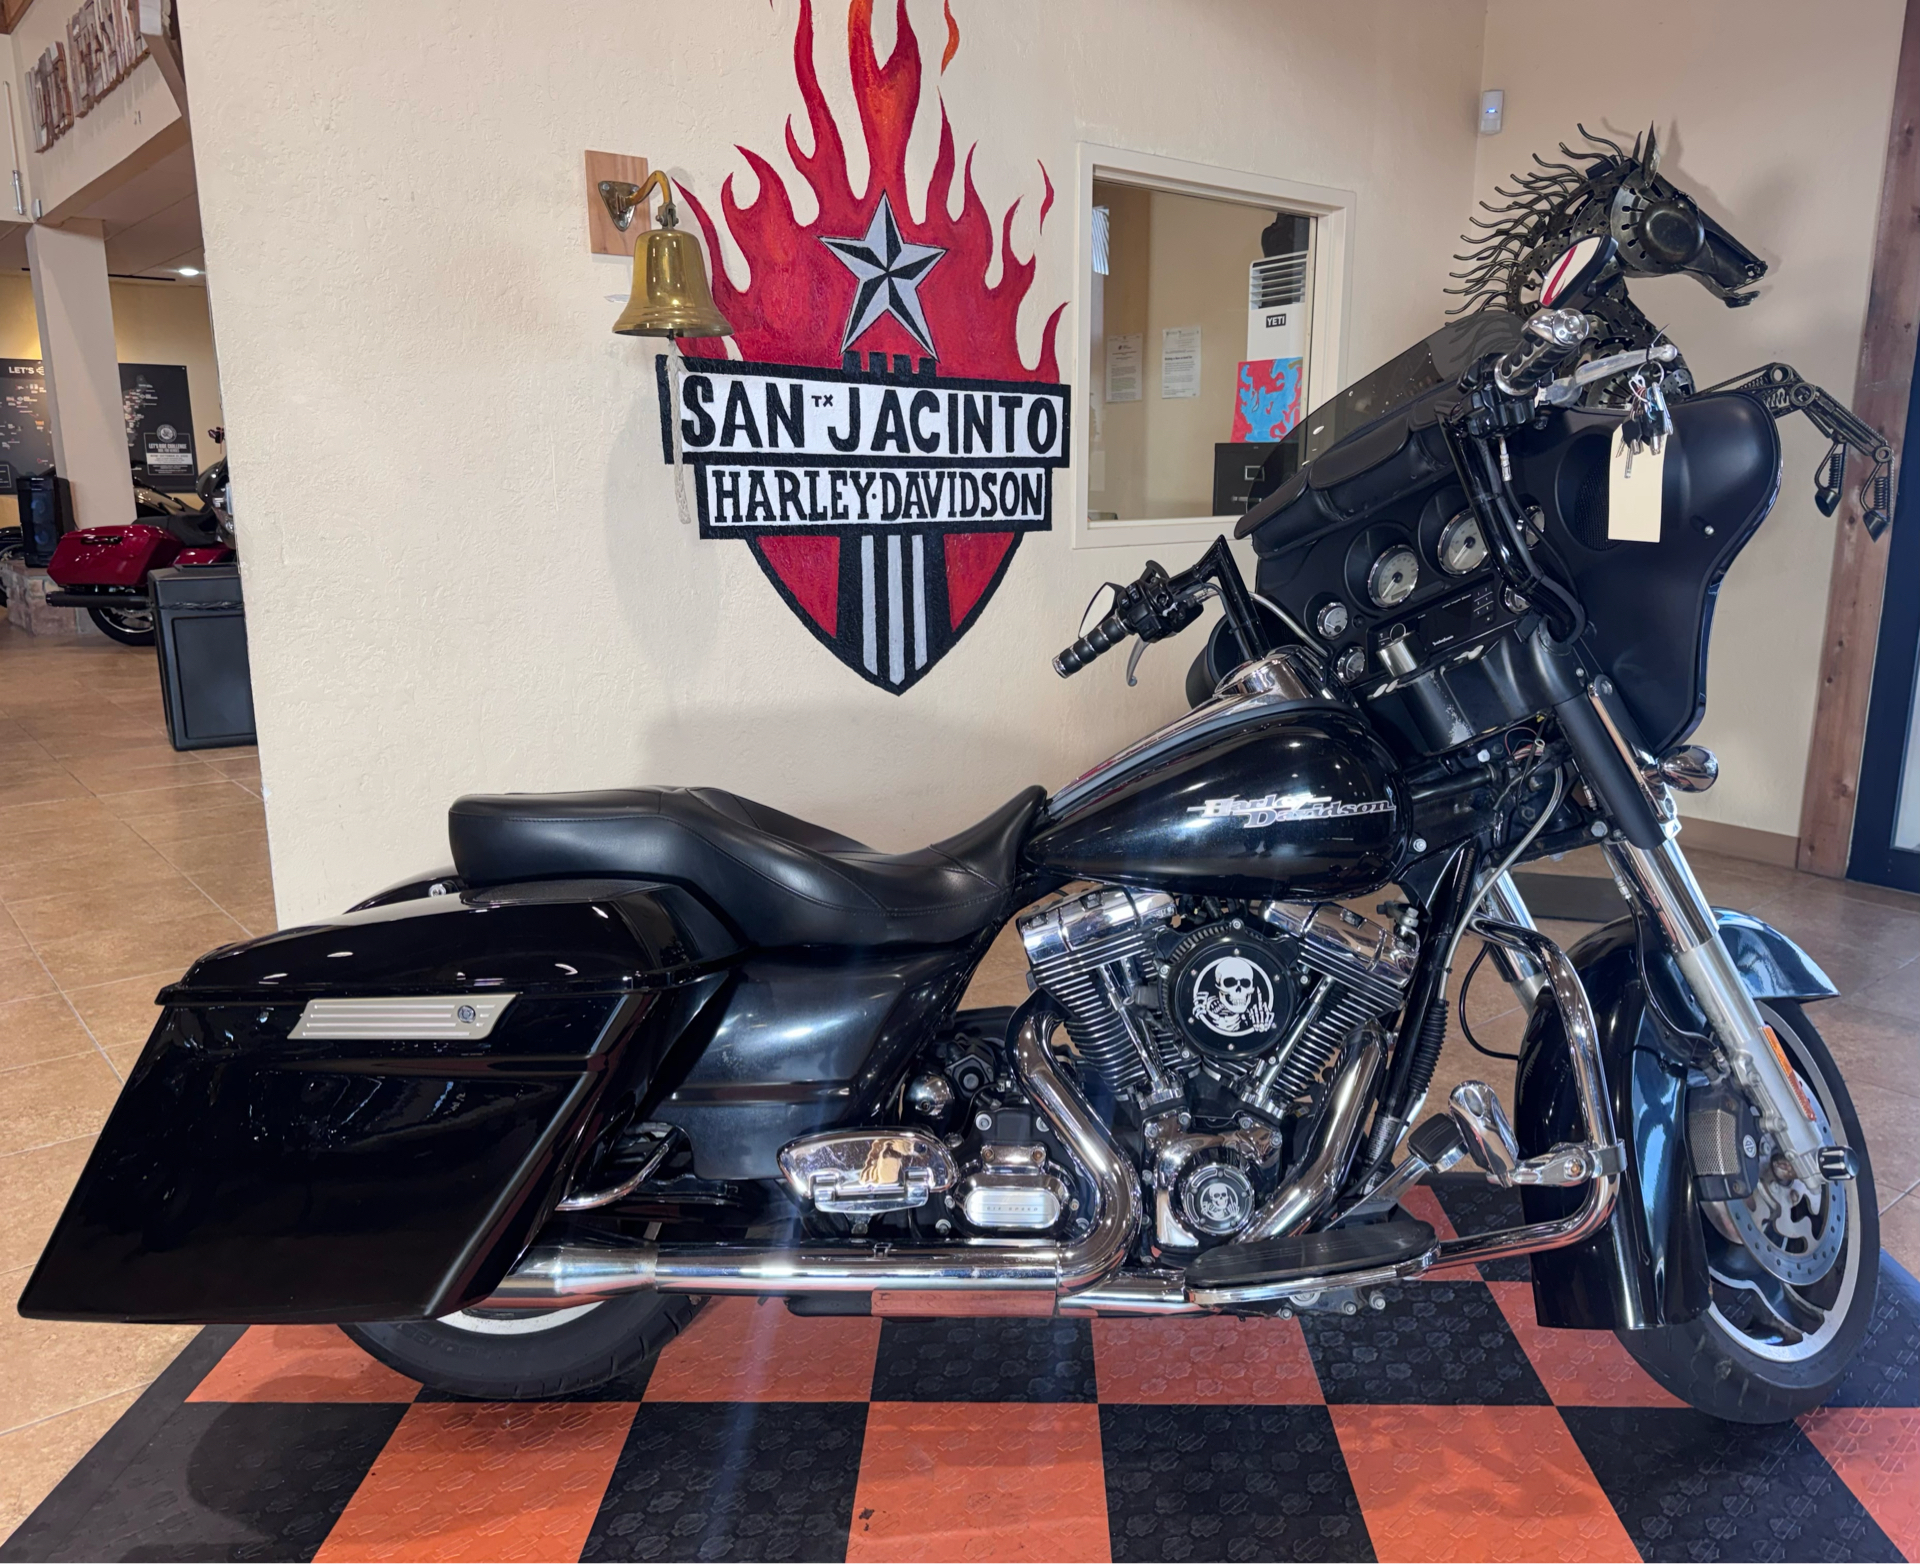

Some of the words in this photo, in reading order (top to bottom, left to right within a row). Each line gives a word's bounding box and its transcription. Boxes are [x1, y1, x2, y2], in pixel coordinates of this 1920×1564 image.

[1267, 315, 1286, 326] YETI
[8, 366, 35, 375] LET'S
[681, 375, 804, 448] SAN
[811, 394, 834, 408] TX
[827, 387, 1058, 455] JACINTO
[1188, 794, 1332, 818] Harley
[1244, 800, 1397, 828] Davidson
